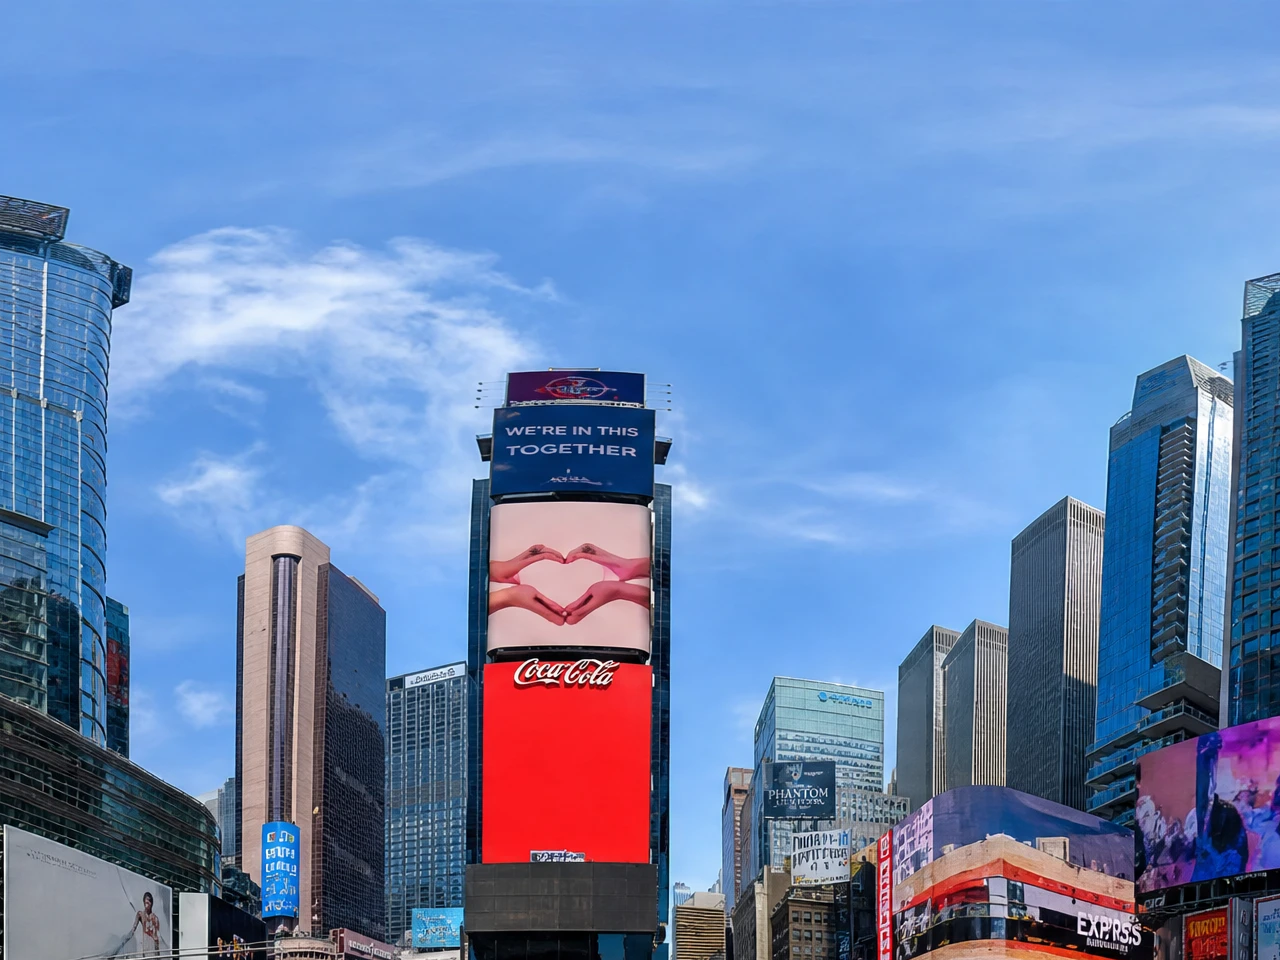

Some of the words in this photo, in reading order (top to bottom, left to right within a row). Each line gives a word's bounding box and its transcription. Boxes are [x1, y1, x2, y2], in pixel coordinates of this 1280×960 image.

[572, 425, 592, 436] IN
[597, 425, 639, 437] THIS
[506, 443, 637, 457] TOGETHER
[768, 787, 829, 800] PHANTOM
